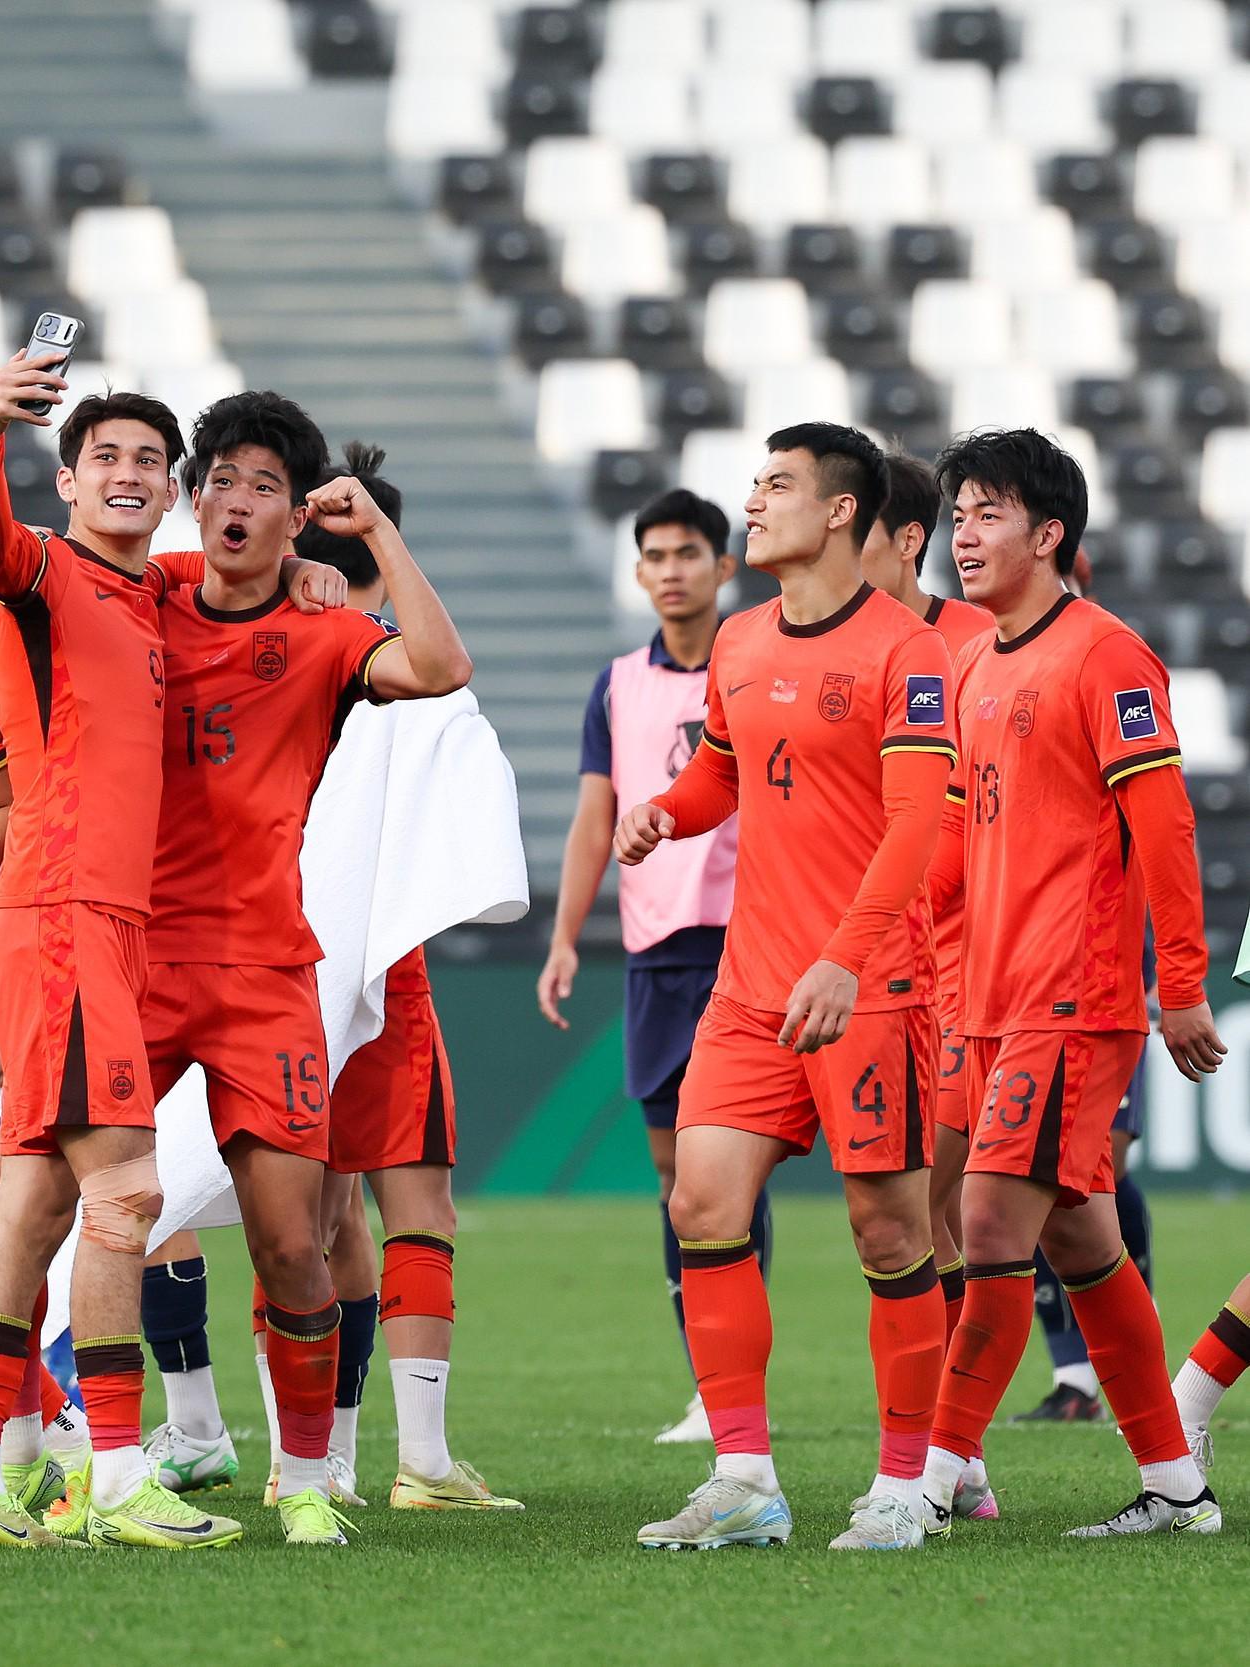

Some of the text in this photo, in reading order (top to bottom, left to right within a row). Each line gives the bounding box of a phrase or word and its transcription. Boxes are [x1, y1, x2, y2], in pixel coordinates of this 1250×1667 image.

[256, 634, 283, 644] CFA
[149, 649, 163, 708] 9
[825, 675, 850, 687] CFA
[910, 693, 939, 705] AFC
[182, 703, 235, 766] 15
[1122, 705, 1149, 721] AFC
[767, 738, 793, 800] 4
[974, 763, 999, 824] 13
[275, 1053, 324, 1113] 15
[851, 1062, 887, 1126] 4
[984, 1068, 1037, 1130] 13
